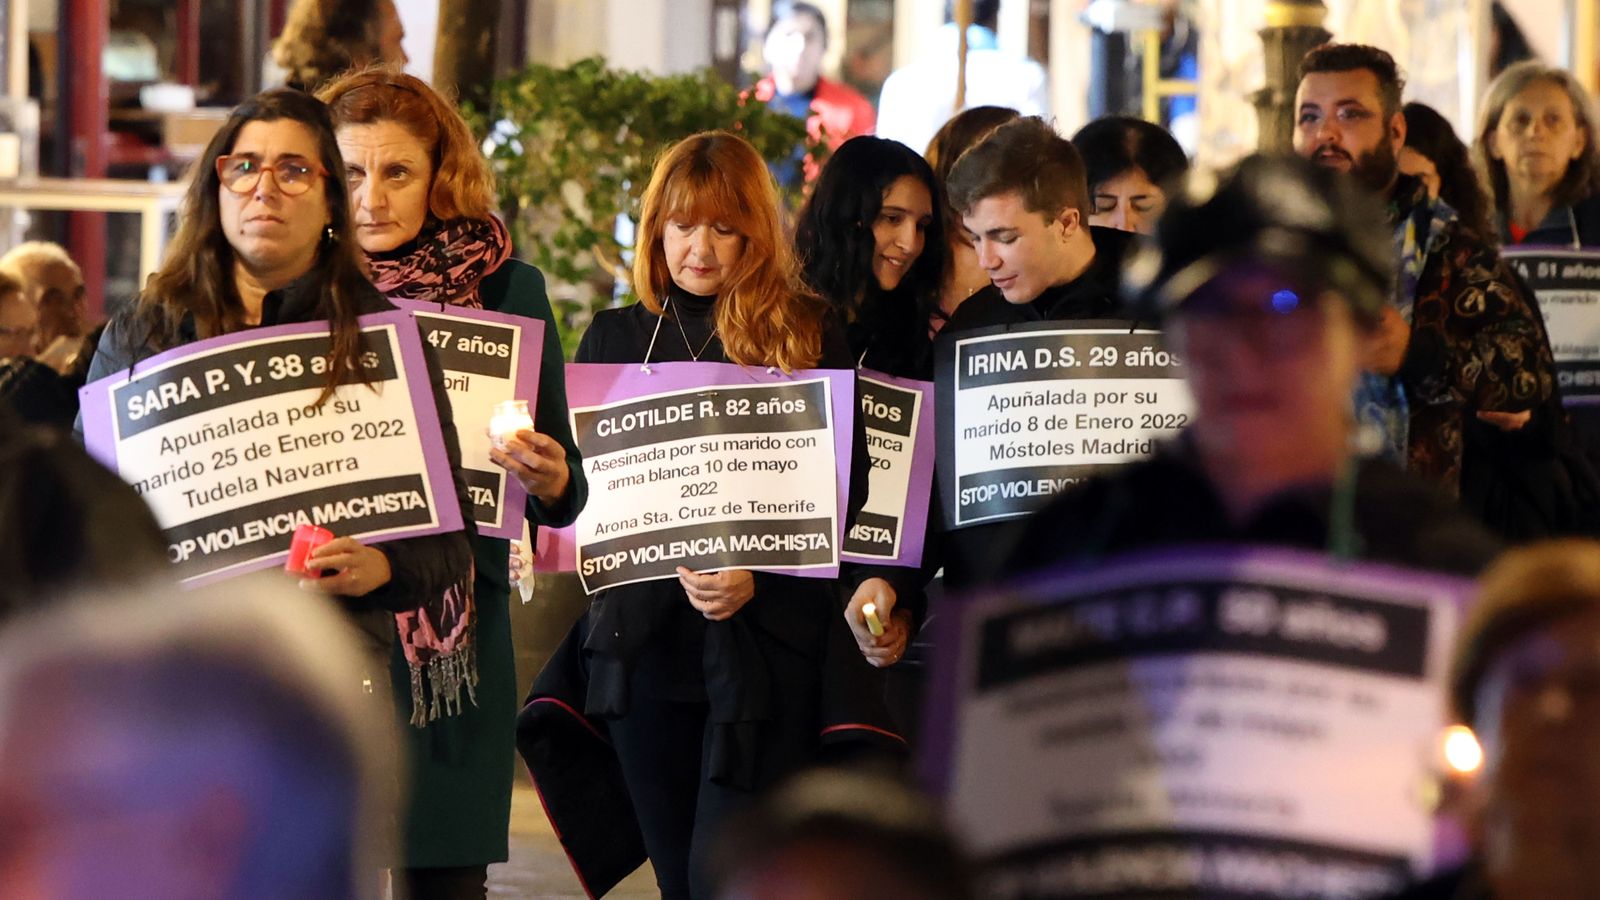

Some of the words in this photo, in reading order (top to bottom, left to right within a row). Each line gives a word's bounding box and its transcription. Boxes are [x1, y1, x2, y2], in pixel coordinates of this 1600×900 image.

[427, 329, 452, 349] 47
[457, 336, 510, 358] años
[968, 350, 1028, 377] IRINA
[1034, 347, 1081, 369] D.S.
[1089, 346, 1118, 366] 29
[127, 376, 201, 421] SARA
[205, 368, 230, 396] P.
[234, 361, 262, 388] Y.
[268, 353, 303, 381] 38
[987, 389, 1087, 412] Apuñalada
[1093, 391, 1128, 408] por
[1133, 392, 1158, 405] su
[159, 411, 280, 457] Apuñalada
[287, 401, 325, 427] por
[333, 398, 361, 415] su
[596, 403, 694, 438] CLOTILDE
[699, 401, 720, 418] R.
[725, 398, 750, 416] 82
[756, 397, 806, 415] años
[963, 418, 1022, 440] marido
[1027, 416, 1038, 432] 8
[1044, 415, 1068, 430] de
[1075, 414, 1134, 430] Enero
[1140, 413, 1188, 430] 2022
[211, 447, 238, 471] 25
[244, 440, 272, 462] de
[278, 429, 345, 454] Enero
[351, 418, 406, 442] 2022
[591, 447, 666, 474] Asesinada
[669, 443, 697, 461] por
[699, 440, 719, 453] su
[723, 435, 781, 451] marido
[785, 435, 816, 449] con
[990, 440, 1075, 461] Móstoles
[1082, 438, 1152, 456] Madrid
[182, 471, 259, 509] Tudela
[265, 456, 359, 489] Navarra
[607, 473, 645, 491] arma
[648, 463, 700, 483] blanca
[705, 459, 723, 474] 10
[727, 456, 748, 472] de
[752, 457, 798, 474] mayo
[680, 480, 718, 498] 2022
[961, 484, 999, 506] STOP
[197, 511, 306, 556] VIOLENCIA
[312, 489, 426, 526] MACHISTA
[594, 517, 638, 536] Arona
[643, 512, 673, 528] Sta.
[678, 505, 717, 520] Cruz
[721, 501, 742, 515] de
[747, 499, 816, 514] Tenerife
[583, 551, 628, 576] STOP
[630, 537, 728, 565] VIOLENCIA
[729, 532, 830, 552] MACHISTA
